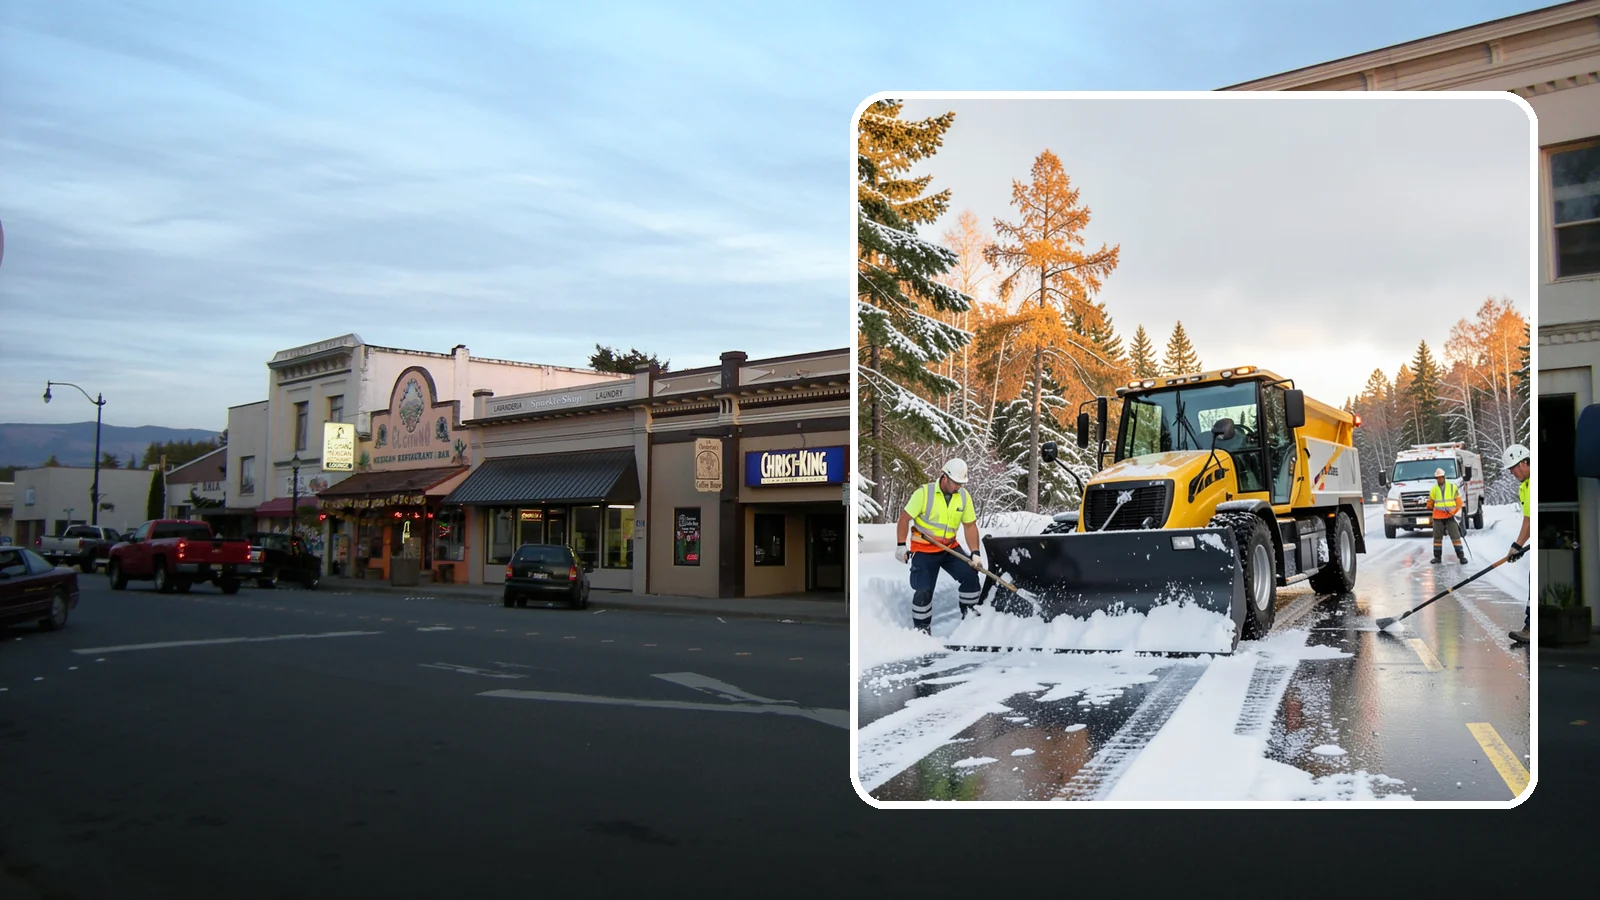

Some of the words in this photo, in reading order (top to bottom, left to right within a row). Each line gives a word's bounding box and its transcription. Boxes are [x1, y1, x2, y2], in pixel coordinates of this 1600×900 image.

[530, 398, 559, 409] Sparkle
[561, 394, 582, 405] Shop
[595, 389, 623, 400] LAUNDRY
[493, 402, 522, 412] LAVANDERIA
[373, 455, 396, 464] MEXICAN
[397, 452, 433, 462] RESTAURANT
[438, 450, 450, 459] BAR
[761, 452, 797, 478] CHRIST
[799, 450, 827, 476] KING
